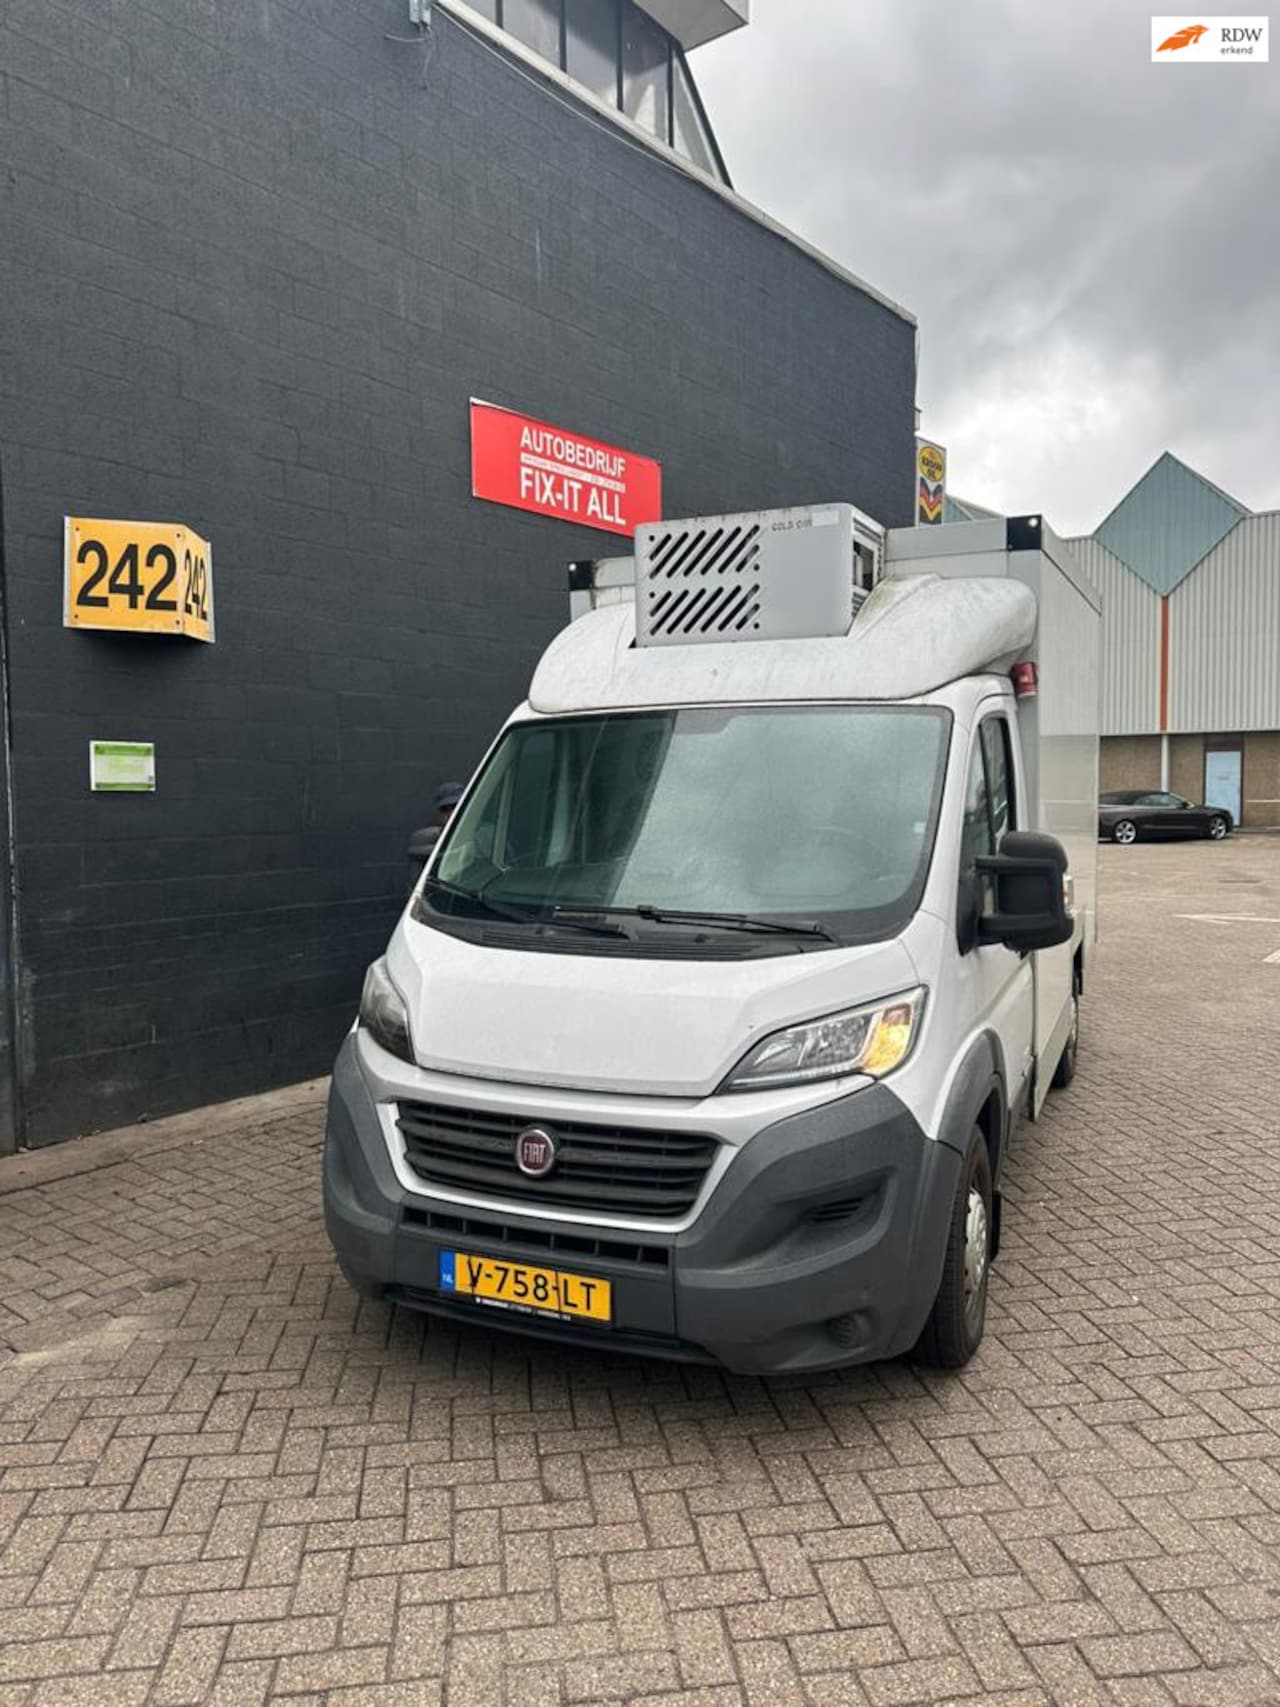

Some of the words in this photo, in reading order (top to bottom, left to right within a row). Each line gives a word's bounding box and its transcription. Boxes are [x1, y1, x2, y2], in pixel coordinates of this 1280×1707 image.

[519, 425, 627, 478] AUTOBEDRIJF
[519, 466, 582, 513] FIX-IT
[586, 487, 627, 526] ALL
[76, 539, 177, 612] 242
[183, 547, 208, 622] 242
[523, 1142, 547, 1164] FIAT
[467, 1256, 597, 1311] V-758-LT
